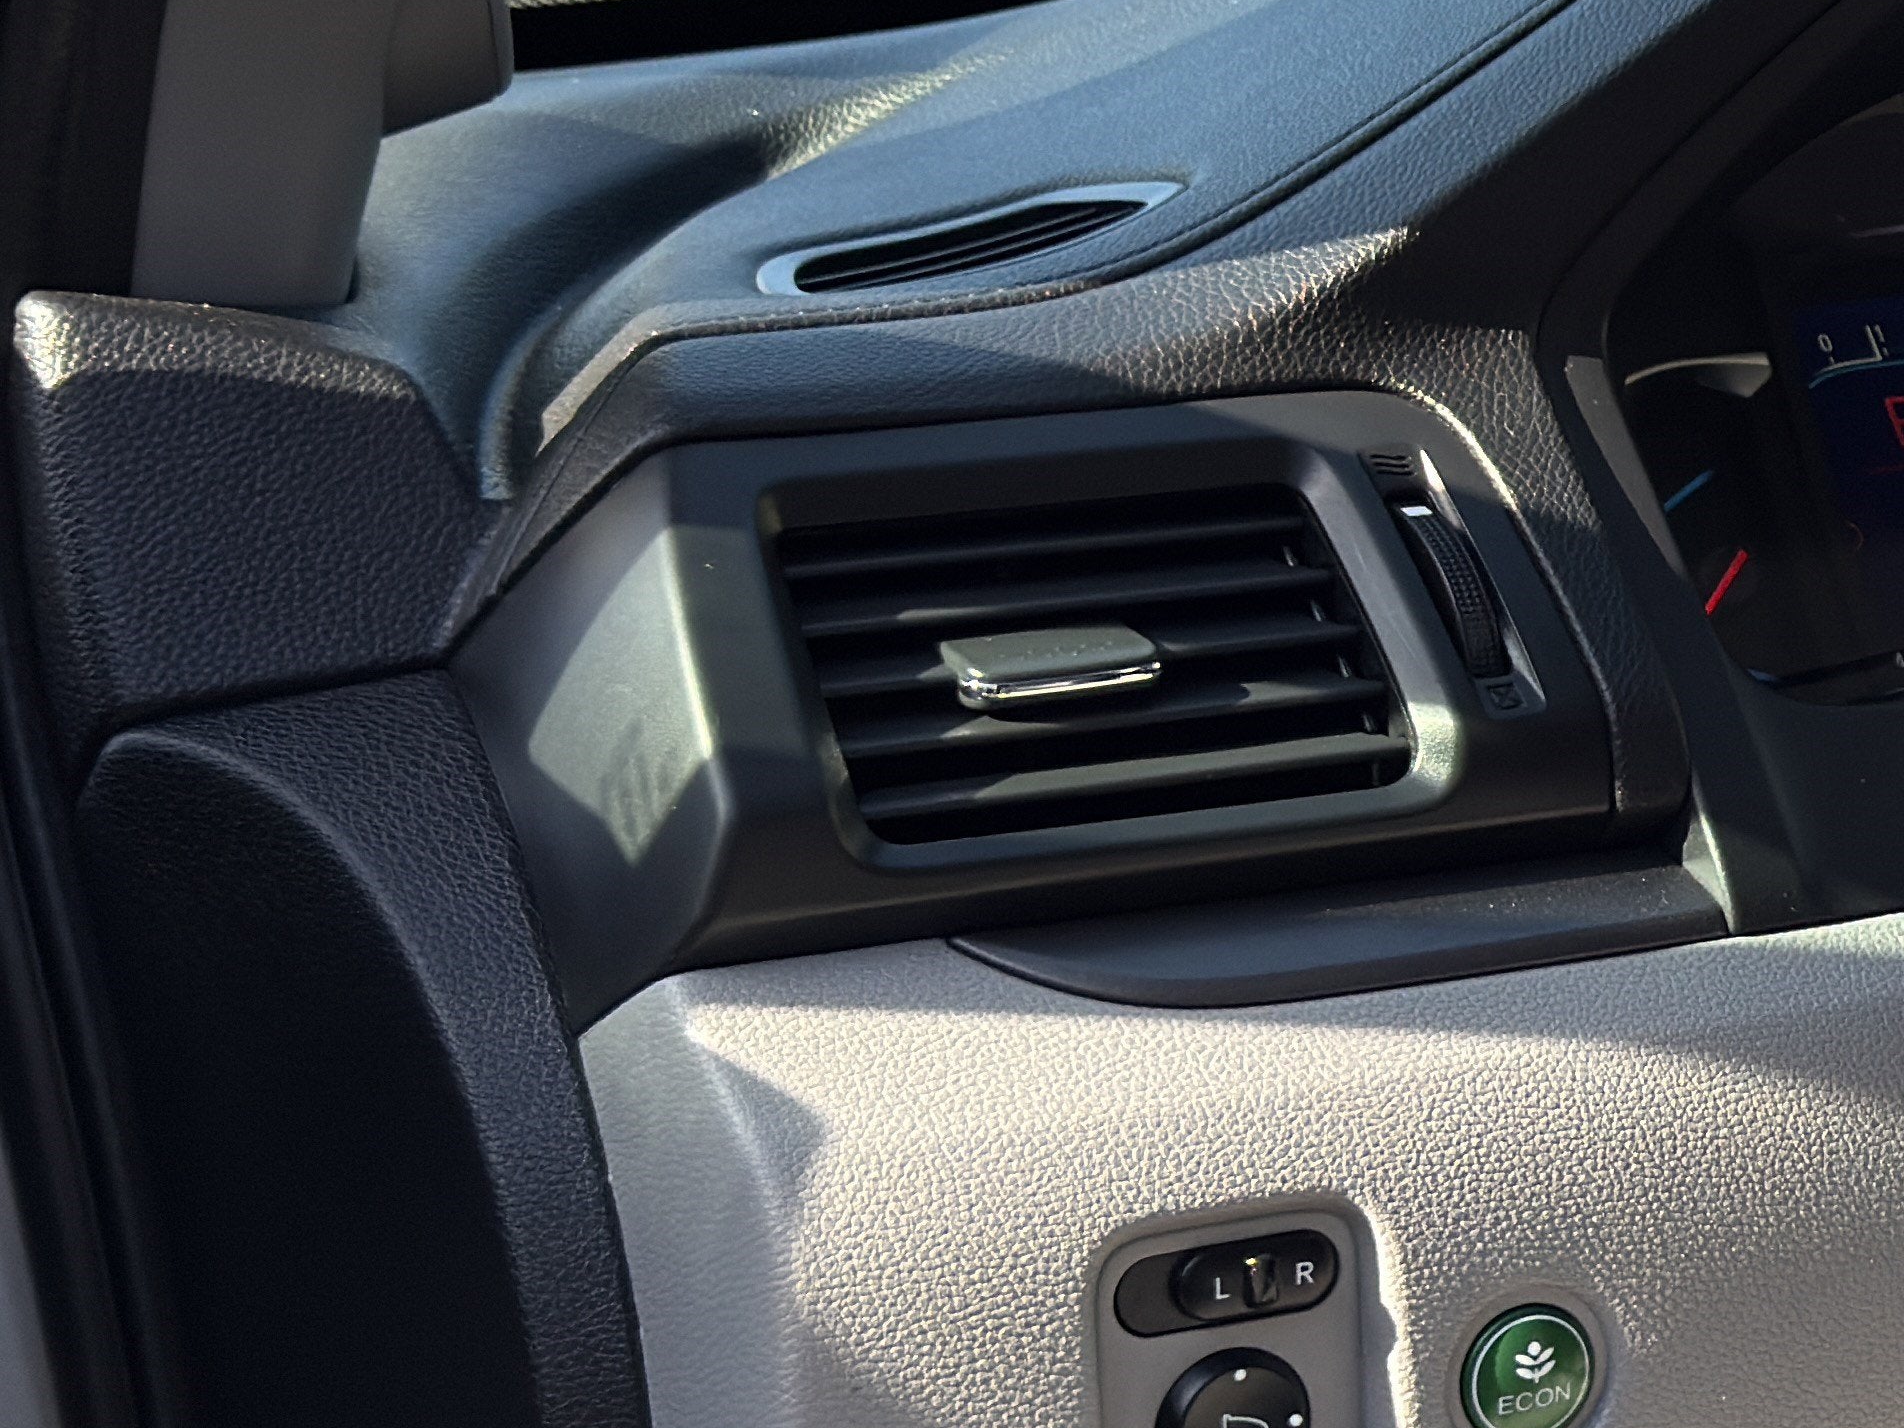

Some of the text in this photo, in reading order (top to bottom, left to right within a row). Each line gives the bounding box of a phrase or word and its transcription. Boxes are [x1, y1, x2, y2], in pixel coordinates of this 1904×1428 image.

[1294, 1260, 1316, 1286] R
[1213, 1277, 1230, 1301] L
[1497, 1381, 1572, 1416] ECON
